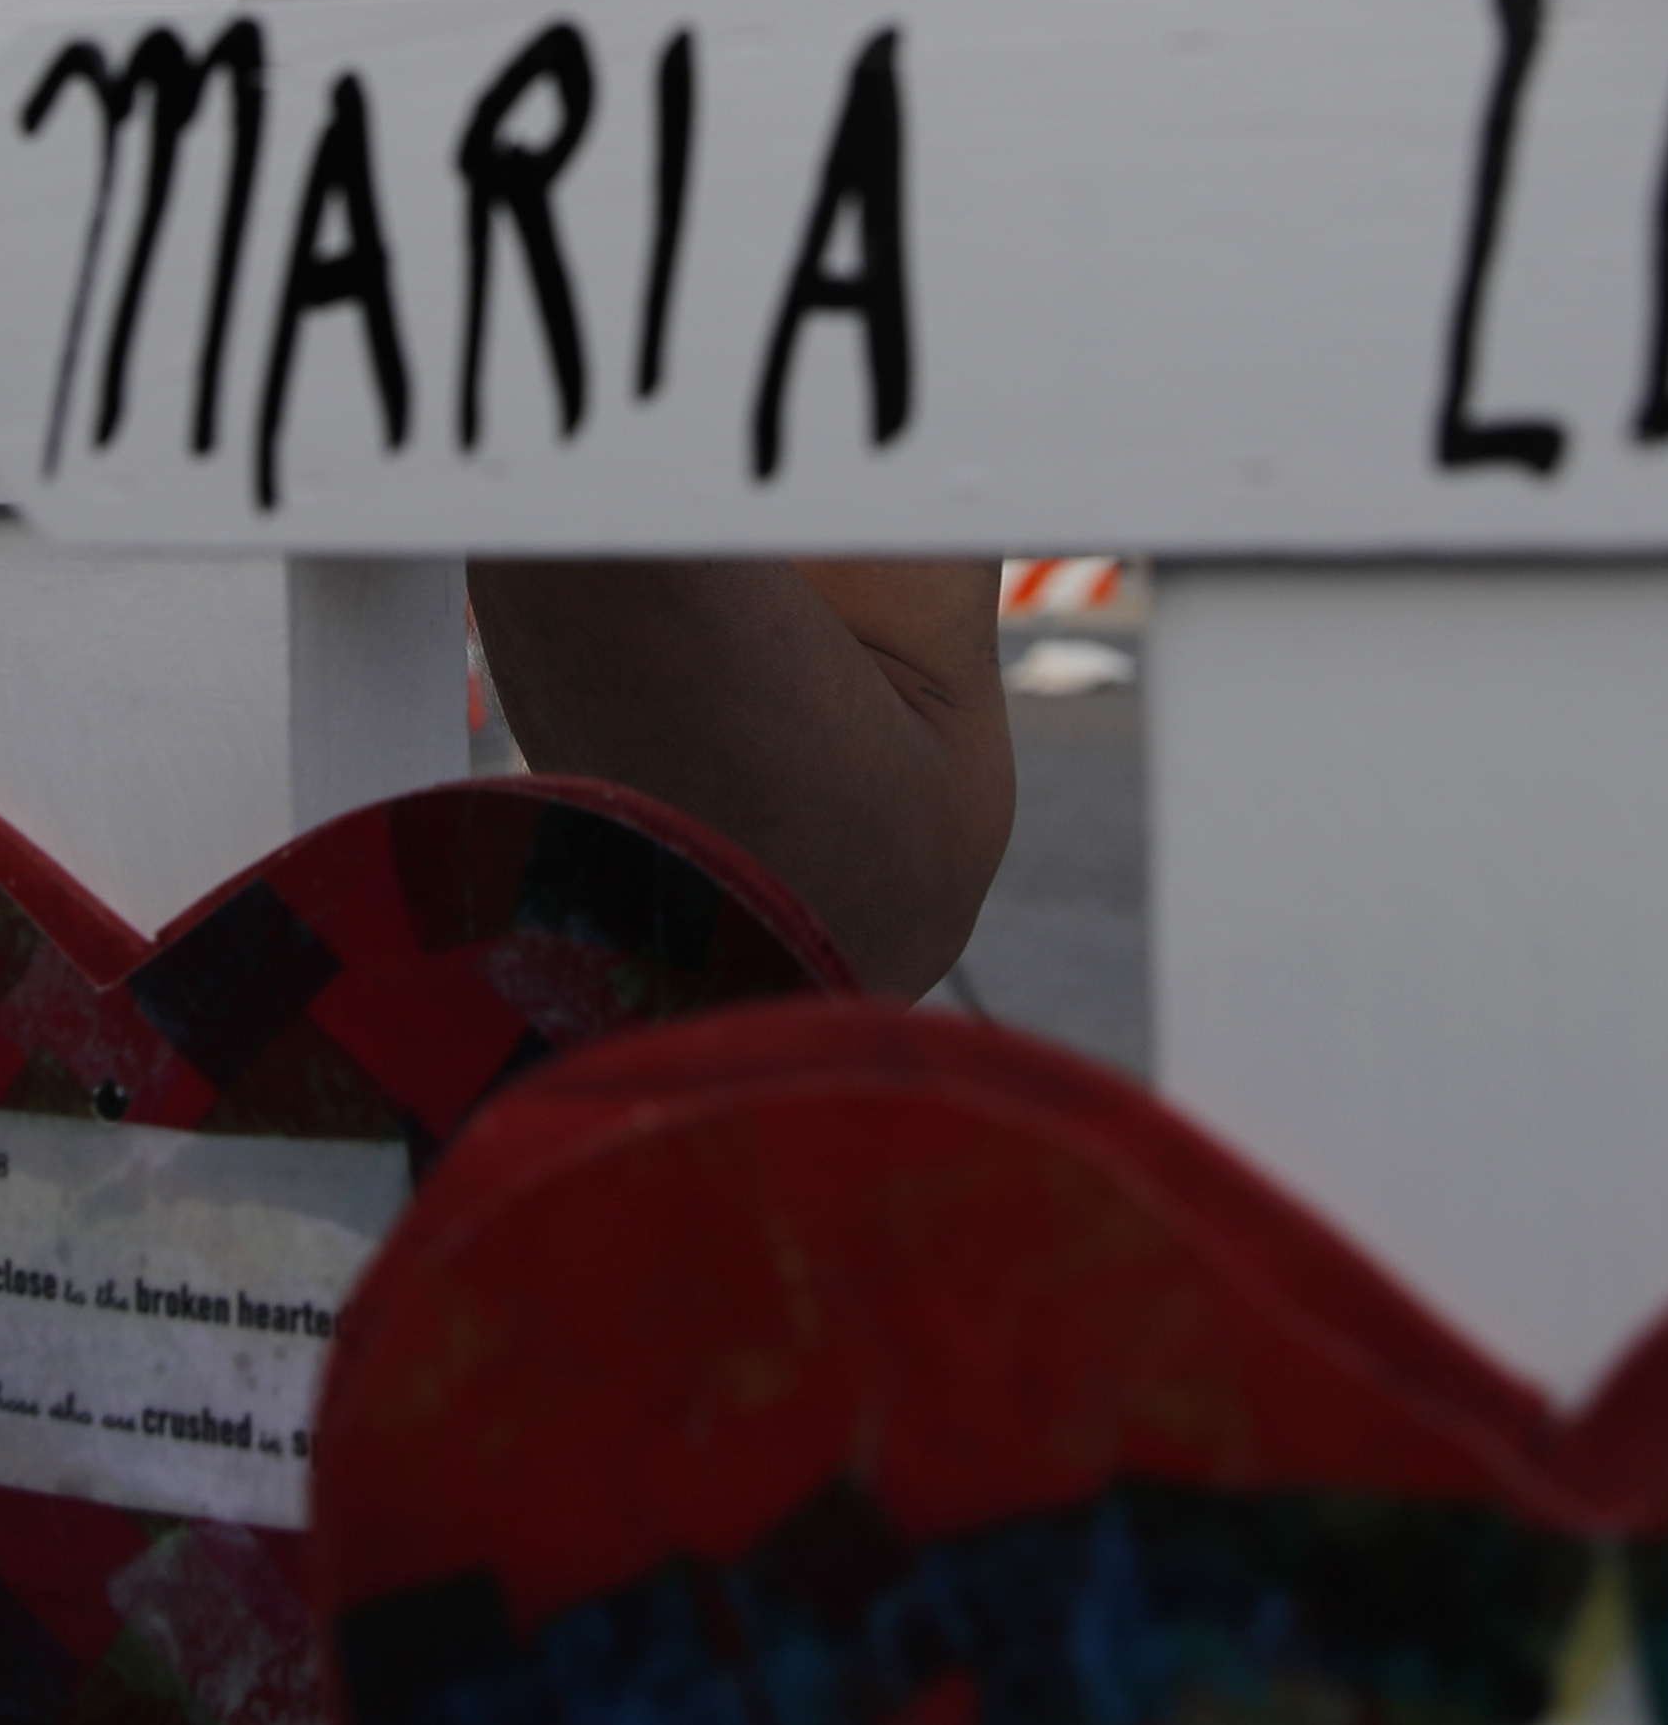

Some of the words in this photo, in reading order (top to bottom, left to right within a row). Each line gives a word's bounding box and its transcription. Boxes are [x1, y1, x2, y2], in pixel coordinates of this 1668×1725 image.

[17, 15, 915, 515] MARIA
[63, 1279, 87, 1306] to
[95, 1278, 130, 1312] the
[135, 1276, 231, 1326] broken
[237, 1289, 333, 1339] hearte
[141, 1406, 253, 1450] crushed
